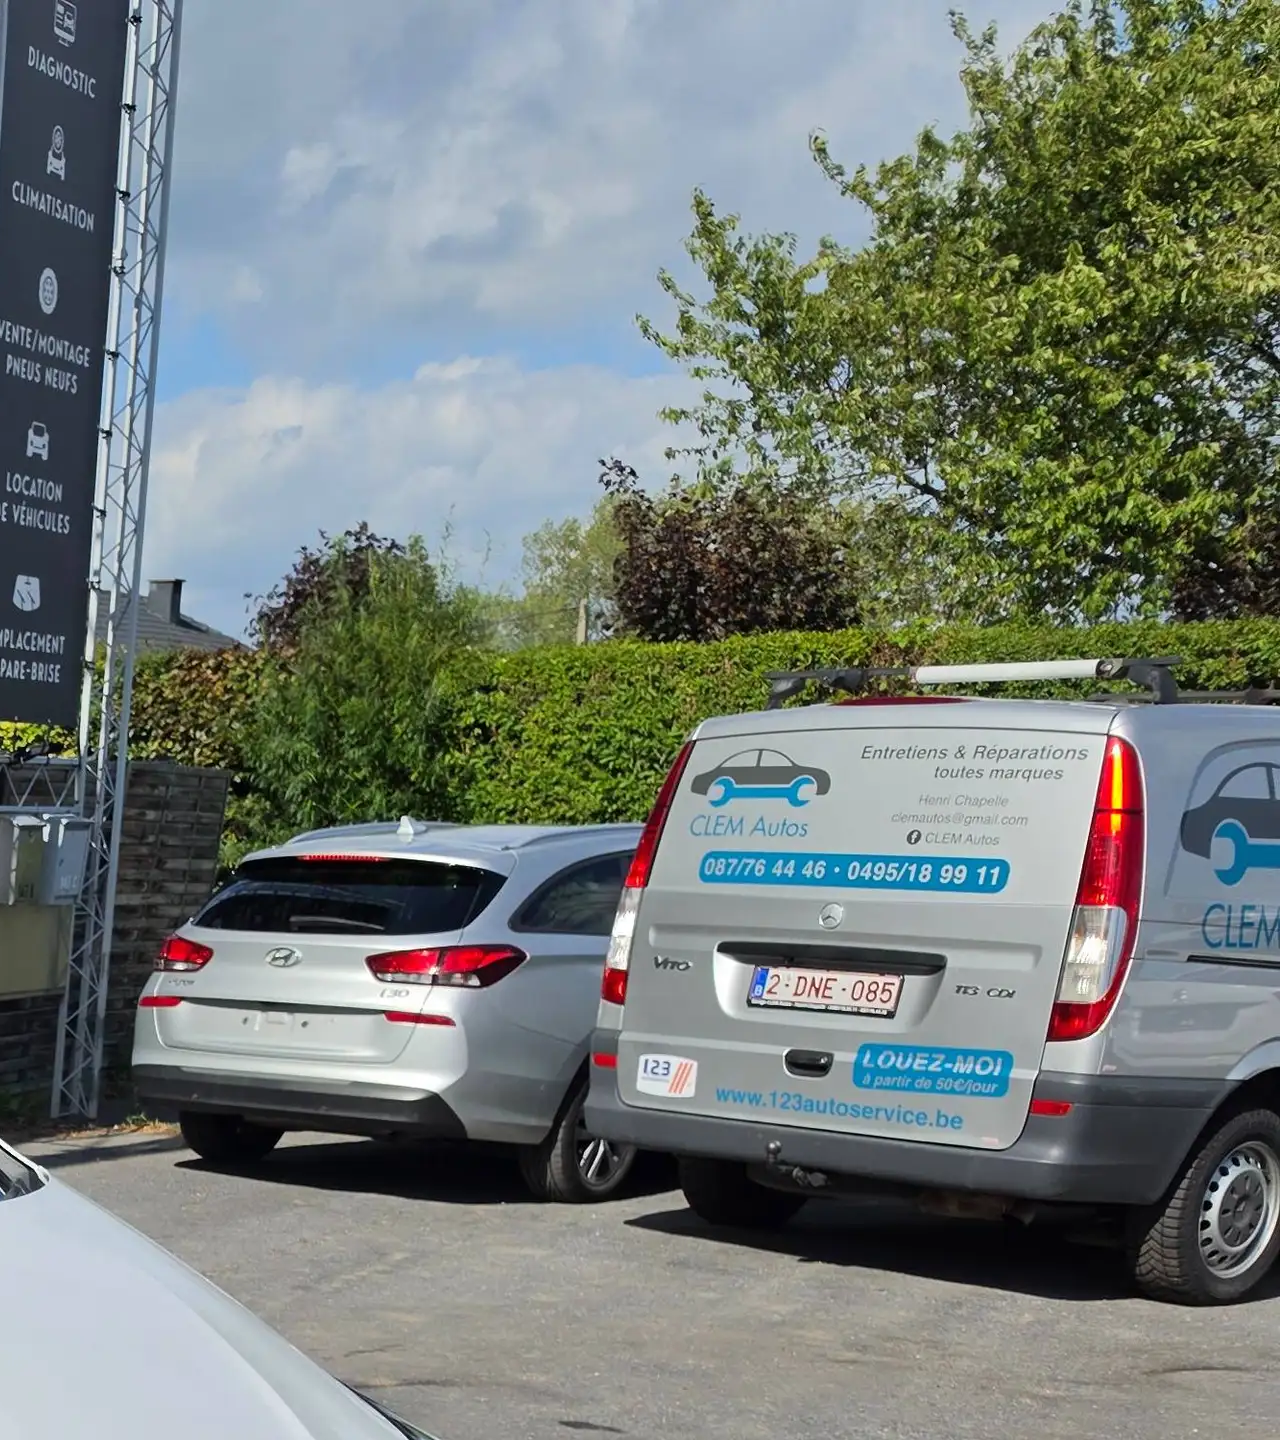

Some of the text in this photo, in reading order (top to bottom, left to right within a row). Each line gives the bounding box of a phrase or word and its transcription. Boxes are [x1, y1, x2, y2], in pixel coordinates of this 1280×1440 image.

[27, 46, 96, 98] DIAGNOSTIC
[12, 181, 95, 231] CLIMATISATION
[6, 353, 78, 394] PNEUS NEUFS
[6, 471, 63, 502] LOCATION
[12, 500, 70, 534] VÉHICULES
[0, 658, 61, 683] PARE-BRISE
[861, 744, 1089, 762] Entretiens & Réparations
[934, 766, 1064, 783] toutes marques
[919, 794, 1009, 808] Henri Chapelle
[690, 815, 808, 838] CLEM Autos
[891, 813, 1028, 827] clemautos@gmail.com
[925, 832, 1000, 846] CLEM Autos
[703, 858, 765, 876] 087/76
[772, 859, 795, 877] 44
[802, 860, 826, 878] 46
[847, 862, 932, 883] 0495/18
[940, 865, 967, 885] 99
[976, 866, 1000, 885] 11
[643, 1059, 671, 1076] 123
[862, 1050, 1003, 1076] LOUEZ-MOI
[862, 1073, 998, 1094] à partir de 50€/jour
[715, 1086, 964, 1131] www.123autoservice.be
